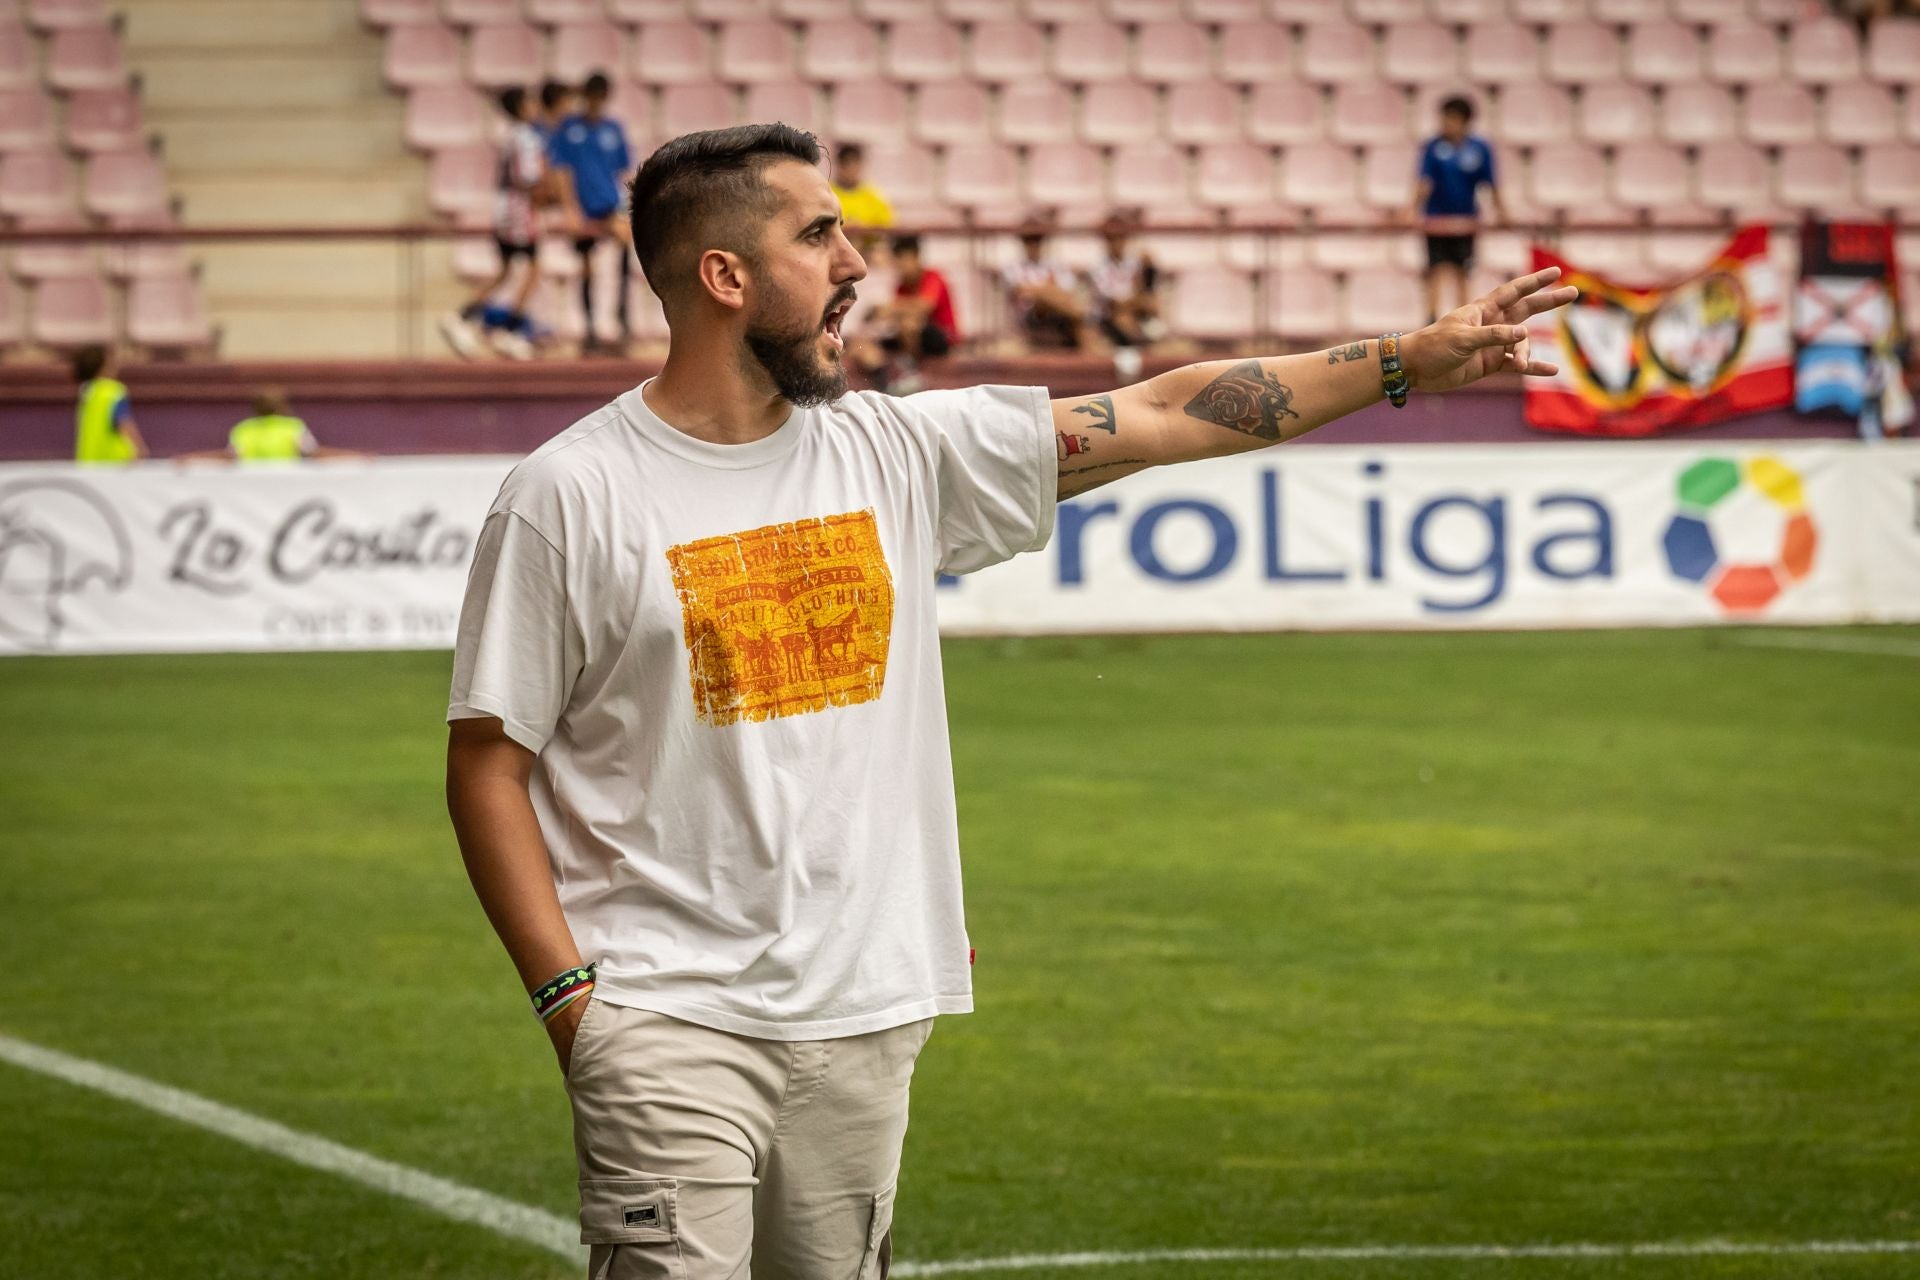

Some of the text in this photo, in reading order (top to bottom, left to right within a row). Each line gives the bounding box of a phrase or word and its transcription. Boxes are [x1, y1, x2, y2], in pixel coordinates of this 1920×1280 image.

[937, 461, 1615, 613] roLiga
[742, 540, 813, 571] STRAUSS
[815, 541, 832, 558] &
[787, 587, 879, 623] CLOTHING
